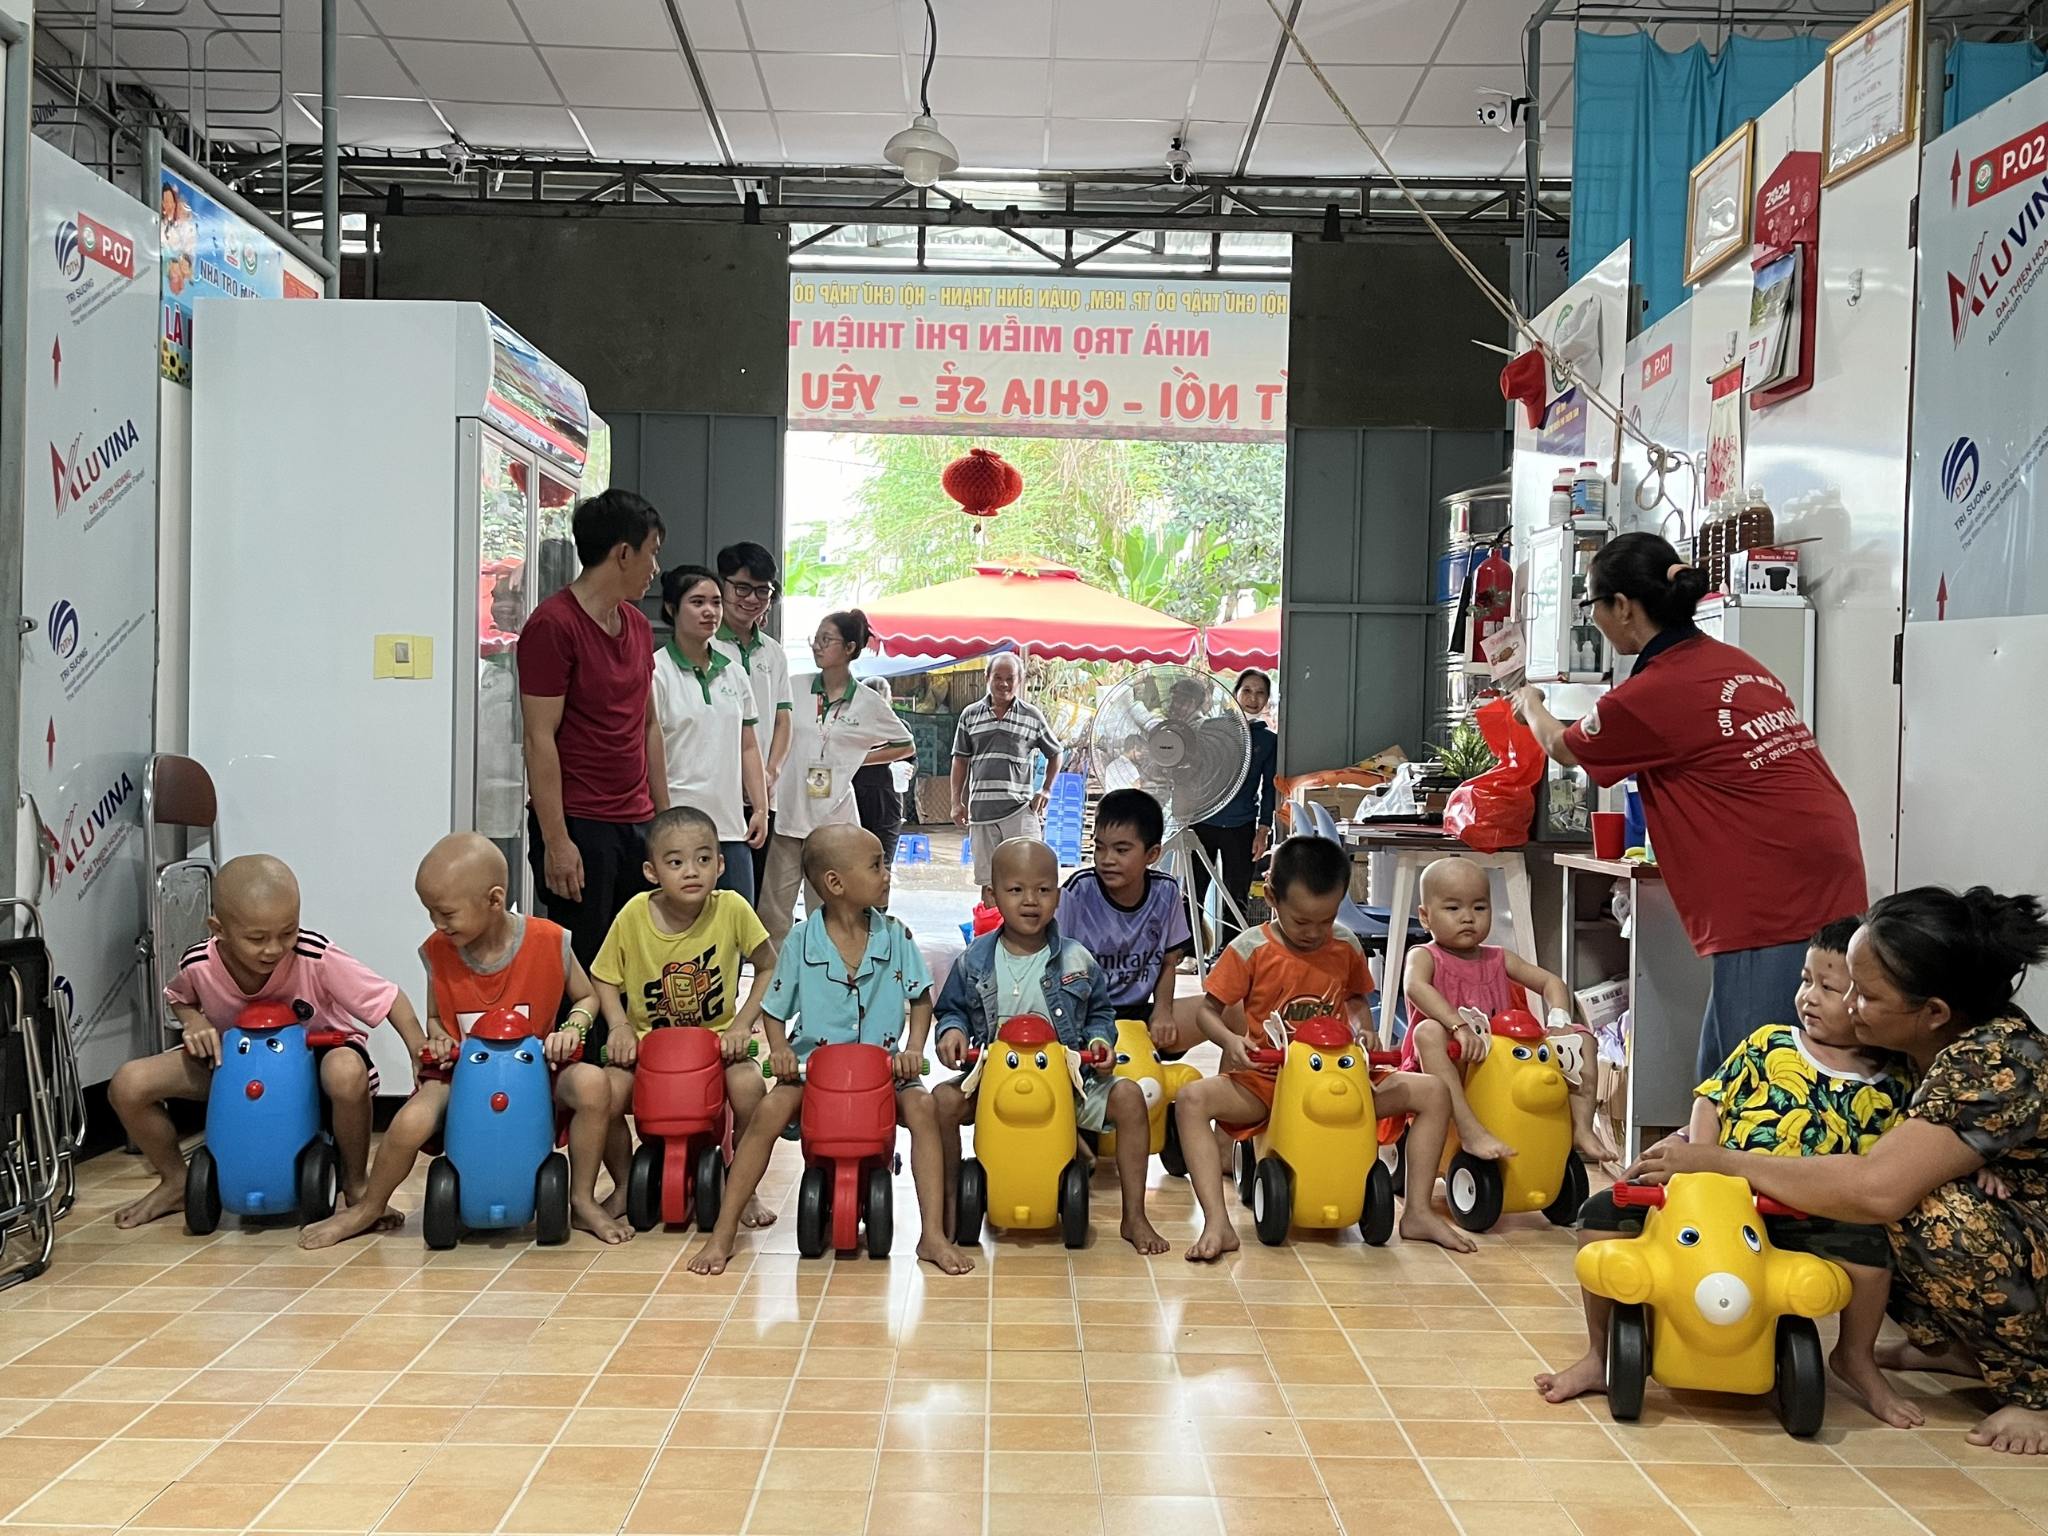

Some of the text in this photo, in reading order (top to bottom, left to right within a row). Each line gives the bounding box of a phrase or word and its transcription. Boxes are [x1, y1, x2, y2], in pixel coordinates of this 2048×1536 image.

[2001, 135, 2046, 179] P.02
[1765, 180, 1791, 209] 2024
[102, 234, 131, 268] P.07
[1995, 297, 2010, 318] DAI
[2008, 262, 2033, 301] THIEN
[165, 304, 183, 346] LÀ
[1988, 293, 2022, 345] Aluminum
[1654, 352, 1670, 376] P.01
[1954, 472, 1972, 499] DTH
[1954, 480, 1992, 531] TRI SUONG
[1718, 708, 1734, 737] CƠM
